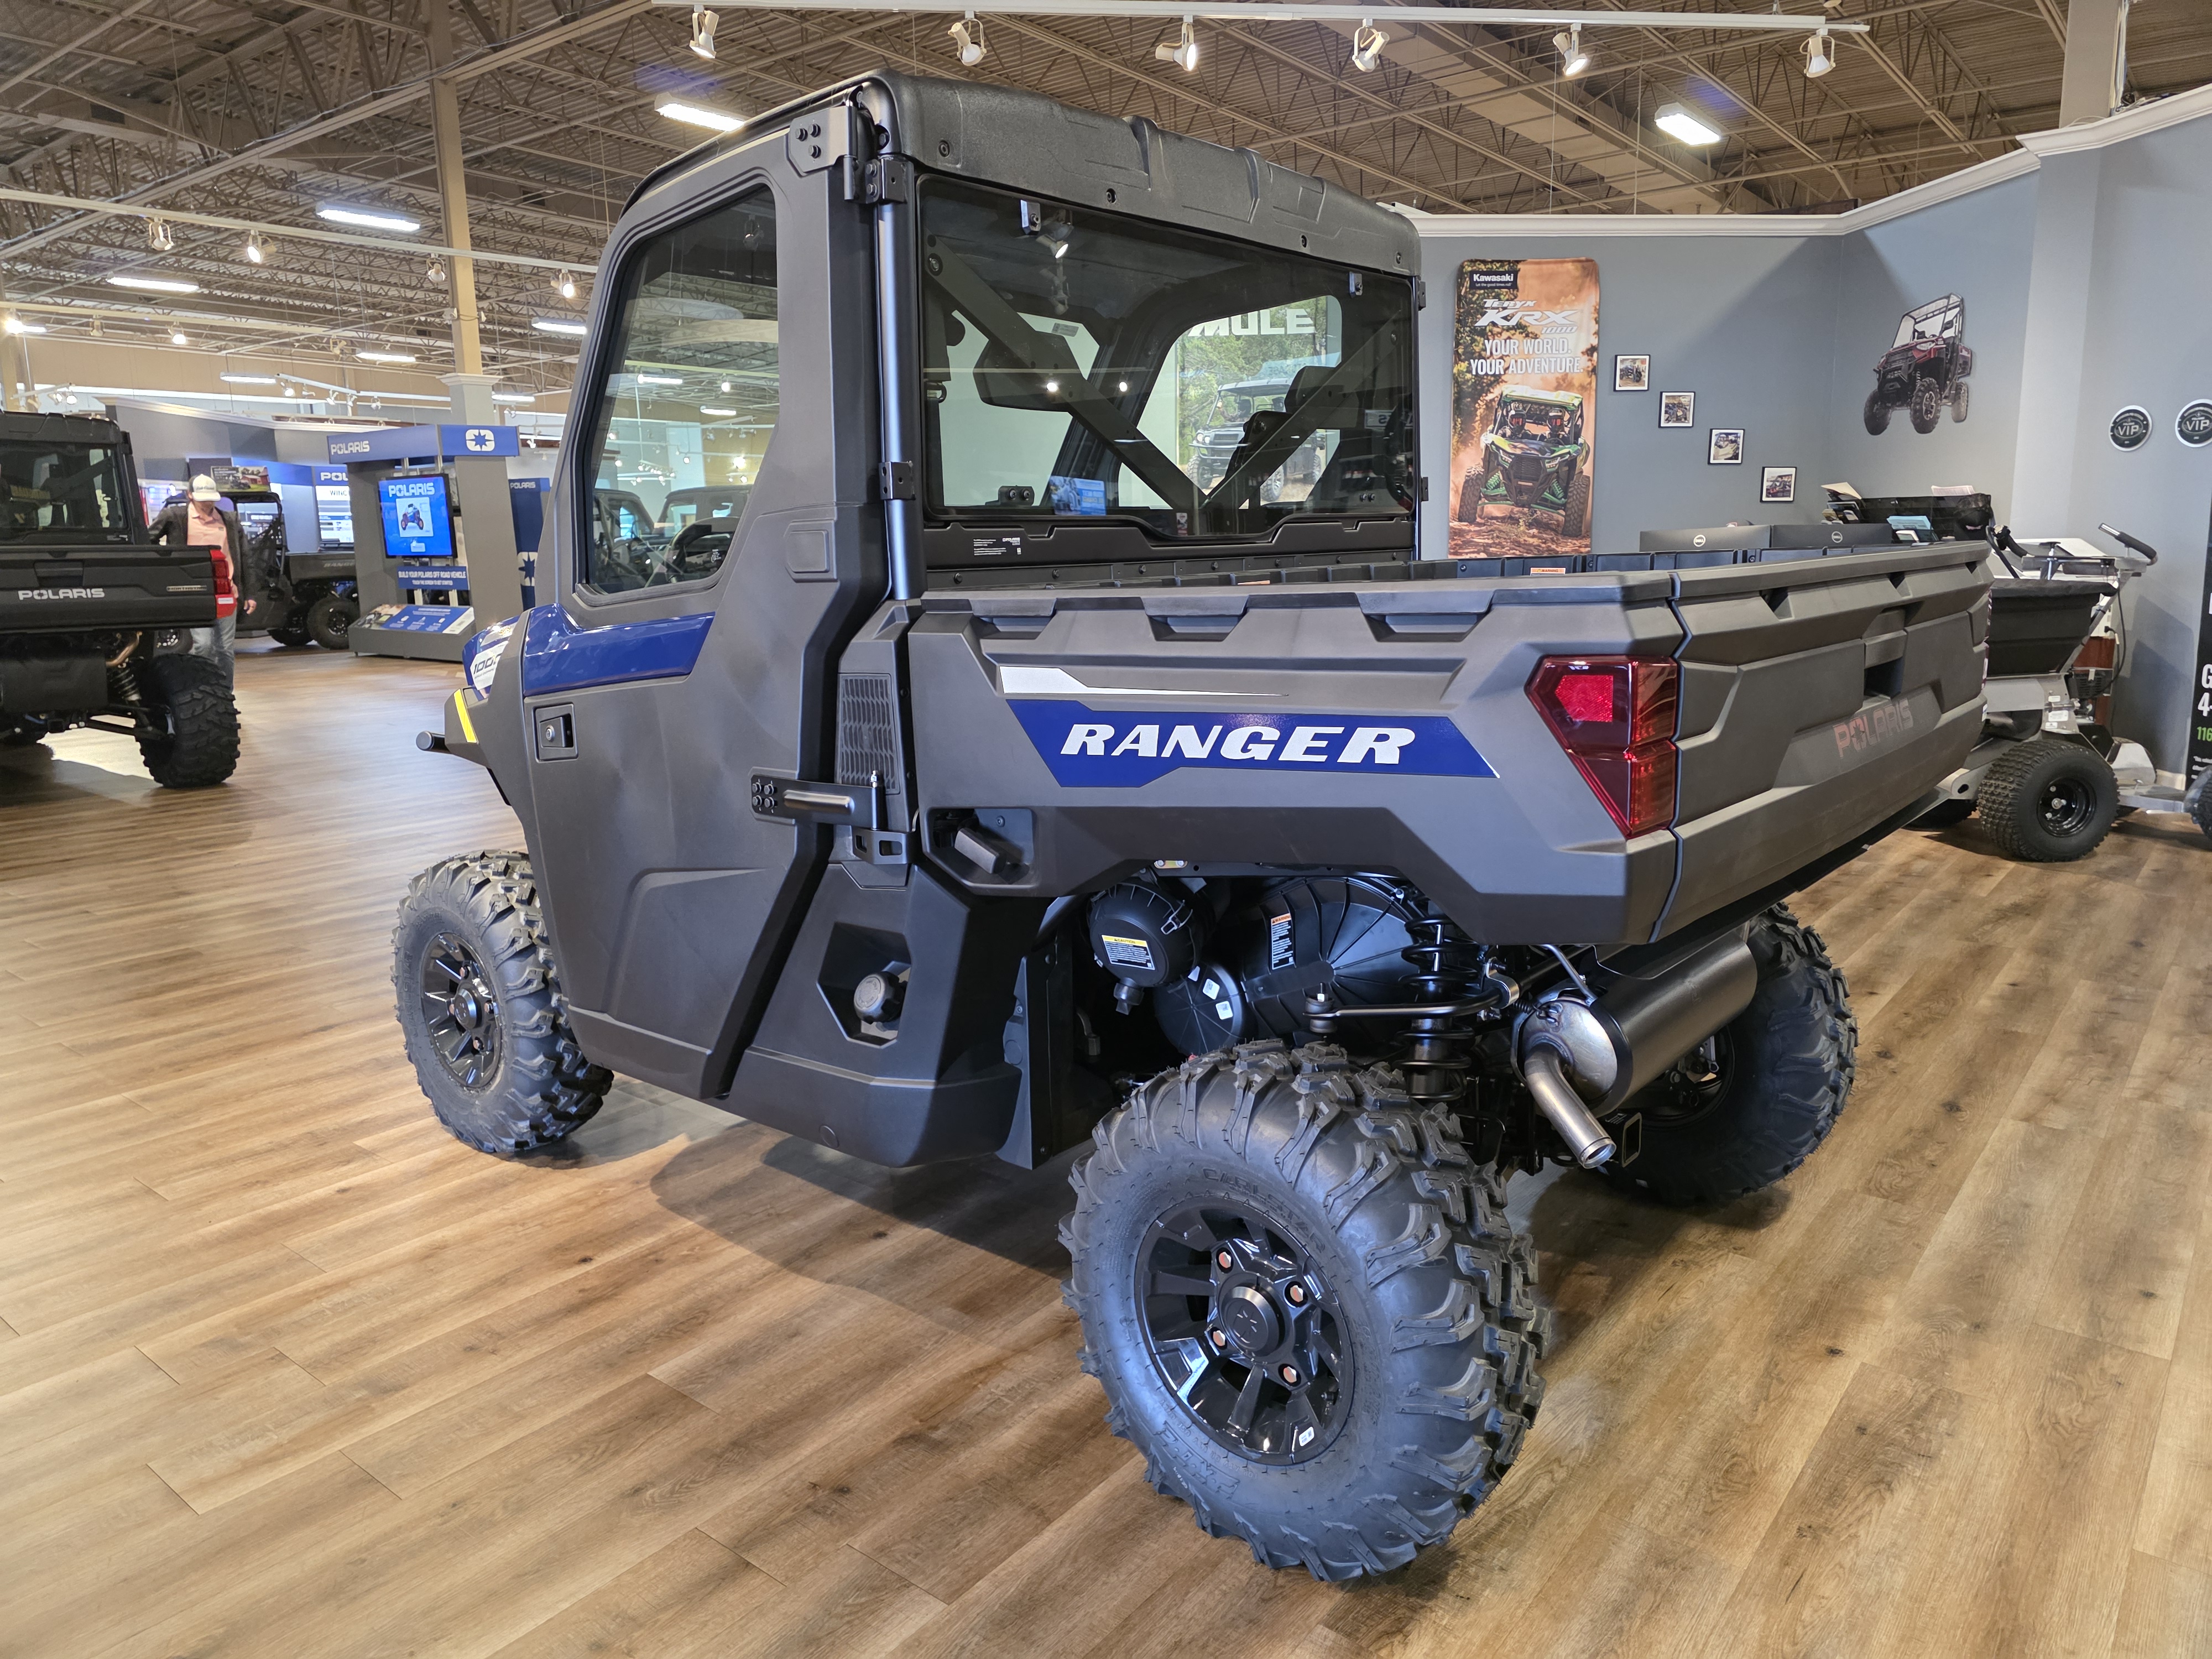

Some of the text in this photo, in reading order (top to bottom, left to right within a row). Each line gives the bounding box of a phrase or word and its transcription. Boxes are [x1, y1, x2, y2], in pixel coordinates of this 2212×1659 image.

[1473, 273, 1514, 282] Kawasaki
[1188, 308, 1316, 337] MULE
[1474, 309, 1579, 326] KRX
[1541, 326, 1578, 334] 1000
[1484, 338, 1571, 356] YOUR WORLD.
[1470, 357, 1583, 375] YOUR ADVENTURE.
[2118, 425, 2139, 435] VIP
[2187, 420, 2210, 430] VIP
[331, 441, 370, 455] POLARIS
[388, 482, 435, 497] POLARIS
[510, 481, 536, 489] POLARIS
[18, 588, 105, 601] POLARIS
[1832, 698, 1914, 759] POLARIS
[1060, 724, 1416, 764] RANGER
